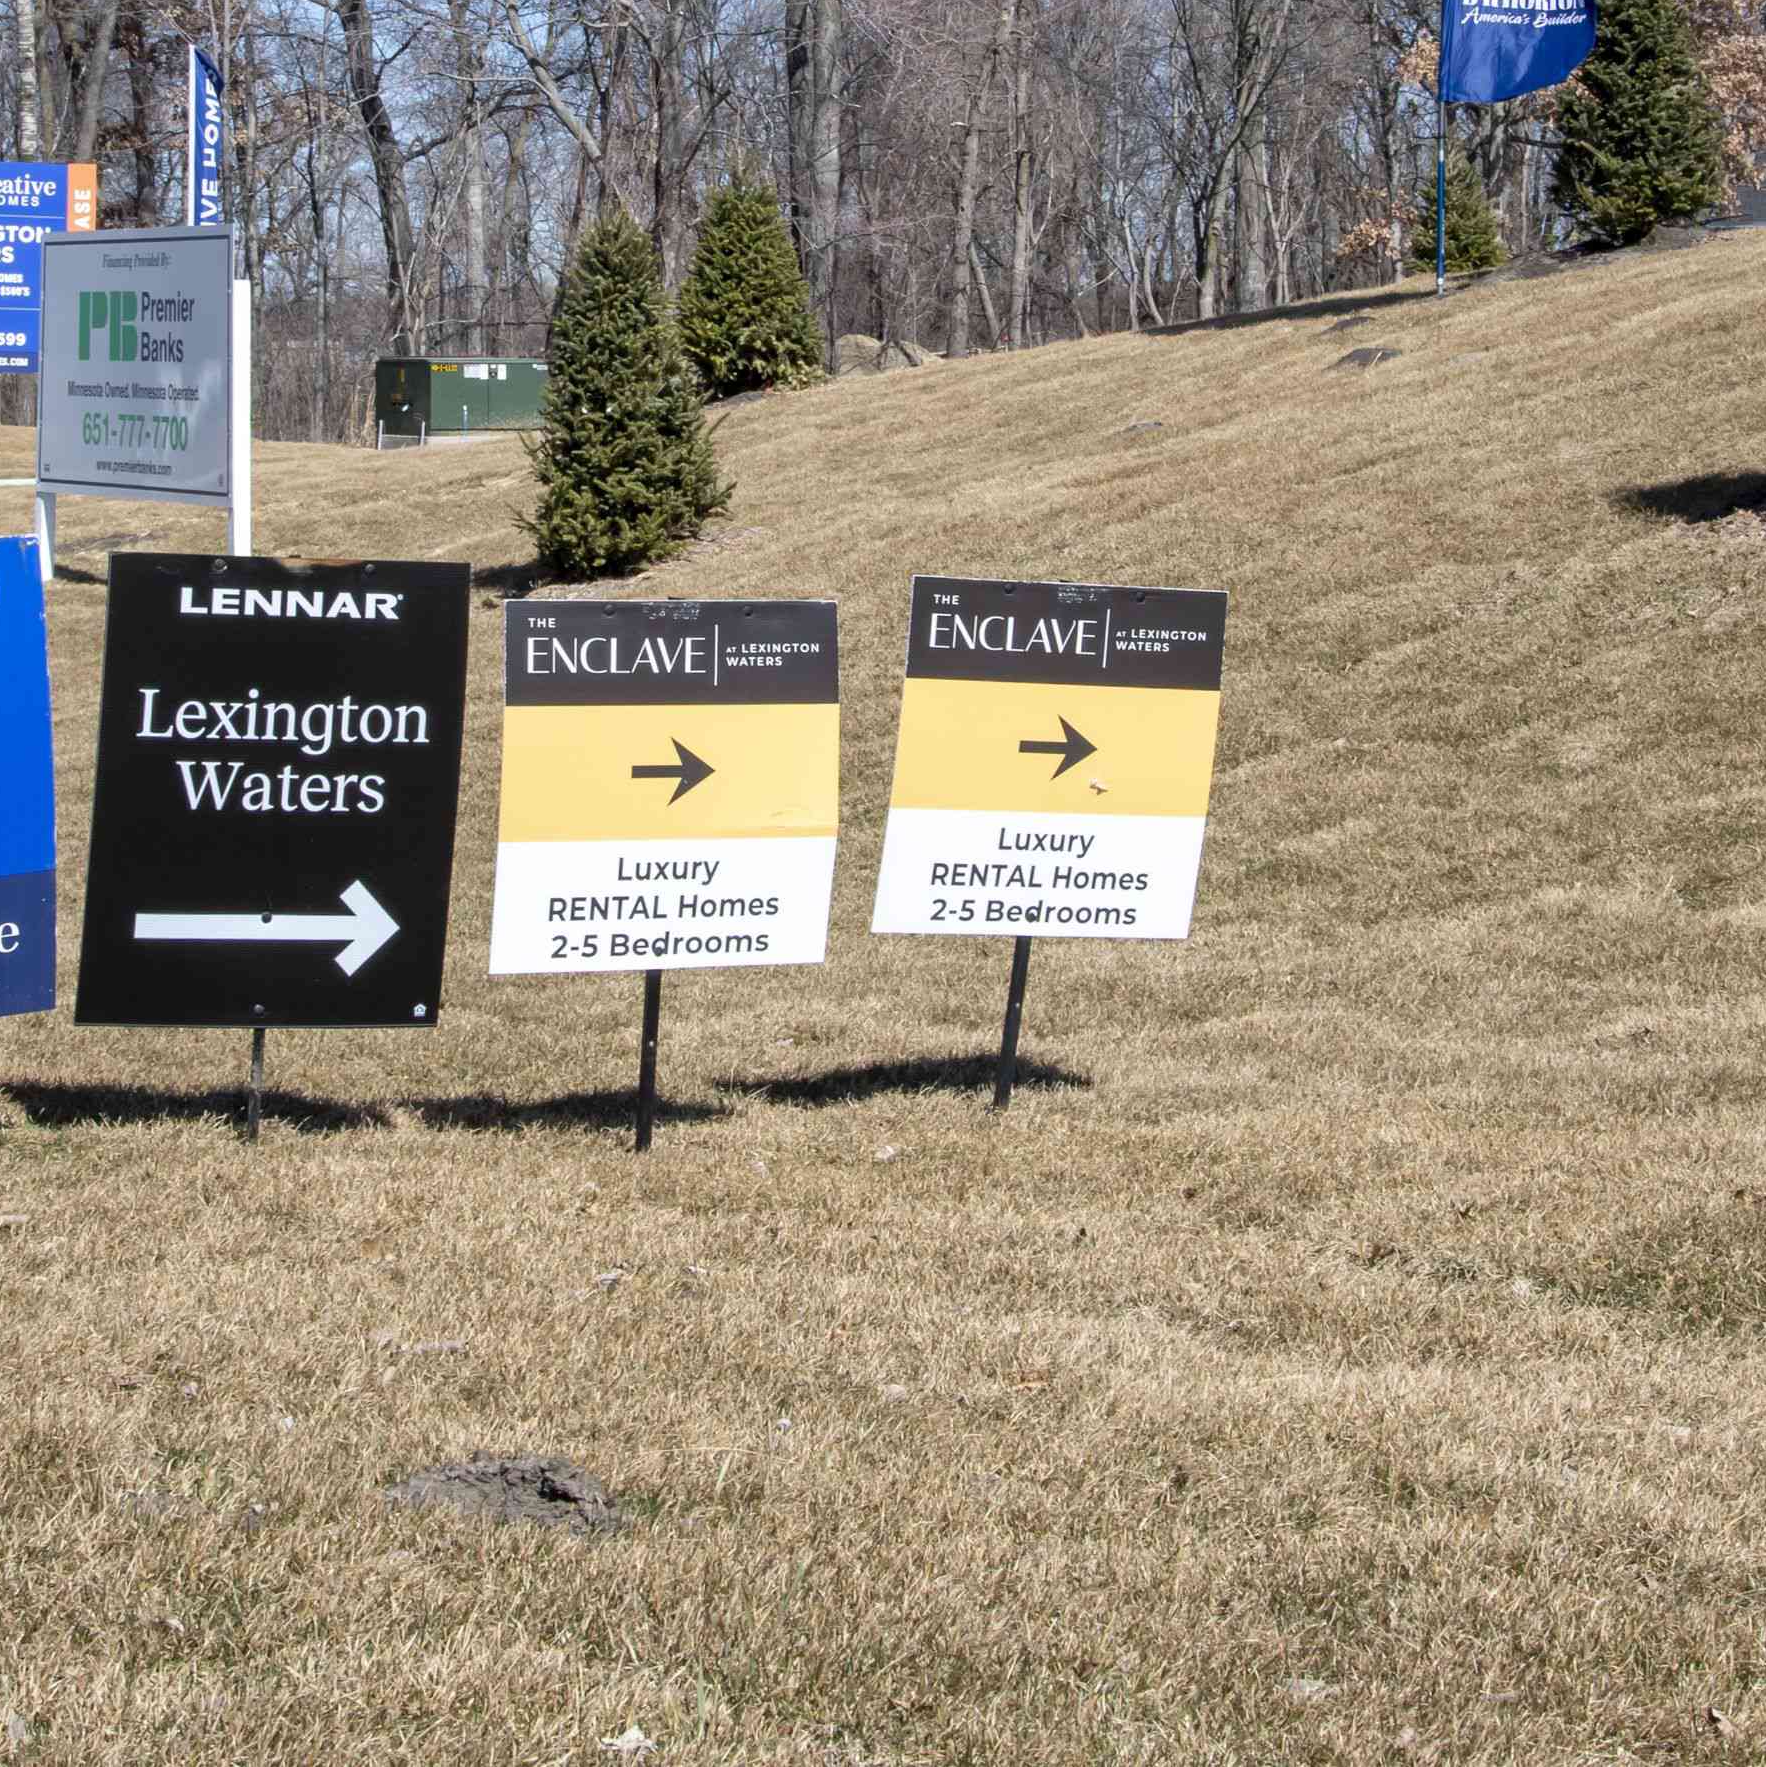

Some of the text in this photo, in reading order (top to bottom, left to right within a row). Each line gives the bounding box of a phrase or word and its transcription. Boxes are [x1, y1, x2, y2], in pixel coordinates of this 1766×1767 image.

[1461, 7, 1587, 28] America's Builder
[141, 290, 194, 322] Premier
[140, 331, 184, 362] Banks
[67, 381, 103, 397] Minnesota
[132, 383, 166, 400] Minnesota
[83, 412, 188, 451] 651-777-7700
[180, 587, 403, 619] LENNAR
[933, 594, 959, 605] THE
[528, 618, 556, 628] THE
[929, 613, 1098, 656] ENCLAVE
[1130, 629, 1207, 641] LEXINGTON
[527, 637, 706, 674] ENCLAVE
[741, 643, 819, 653] LEXINGTON
[1115, 641, 1170, 652] WATERS
[726, 656, 782, 667] WATERS
[136, 688, 430, 755] Lexington
[176, 761, 385, 813] Waters
[998, 827, 1095, 859] Luxury
[617, 857, 720, 886] Luxury
[931, 863, 1148, 891] RENTAL Homes
[548, 894, 779, 921] RENTAL Homes
[930, 899, 1137, 925] 2-5 Bedrooms
[551, 931, 769, 959] 2-5 Bedrooms
